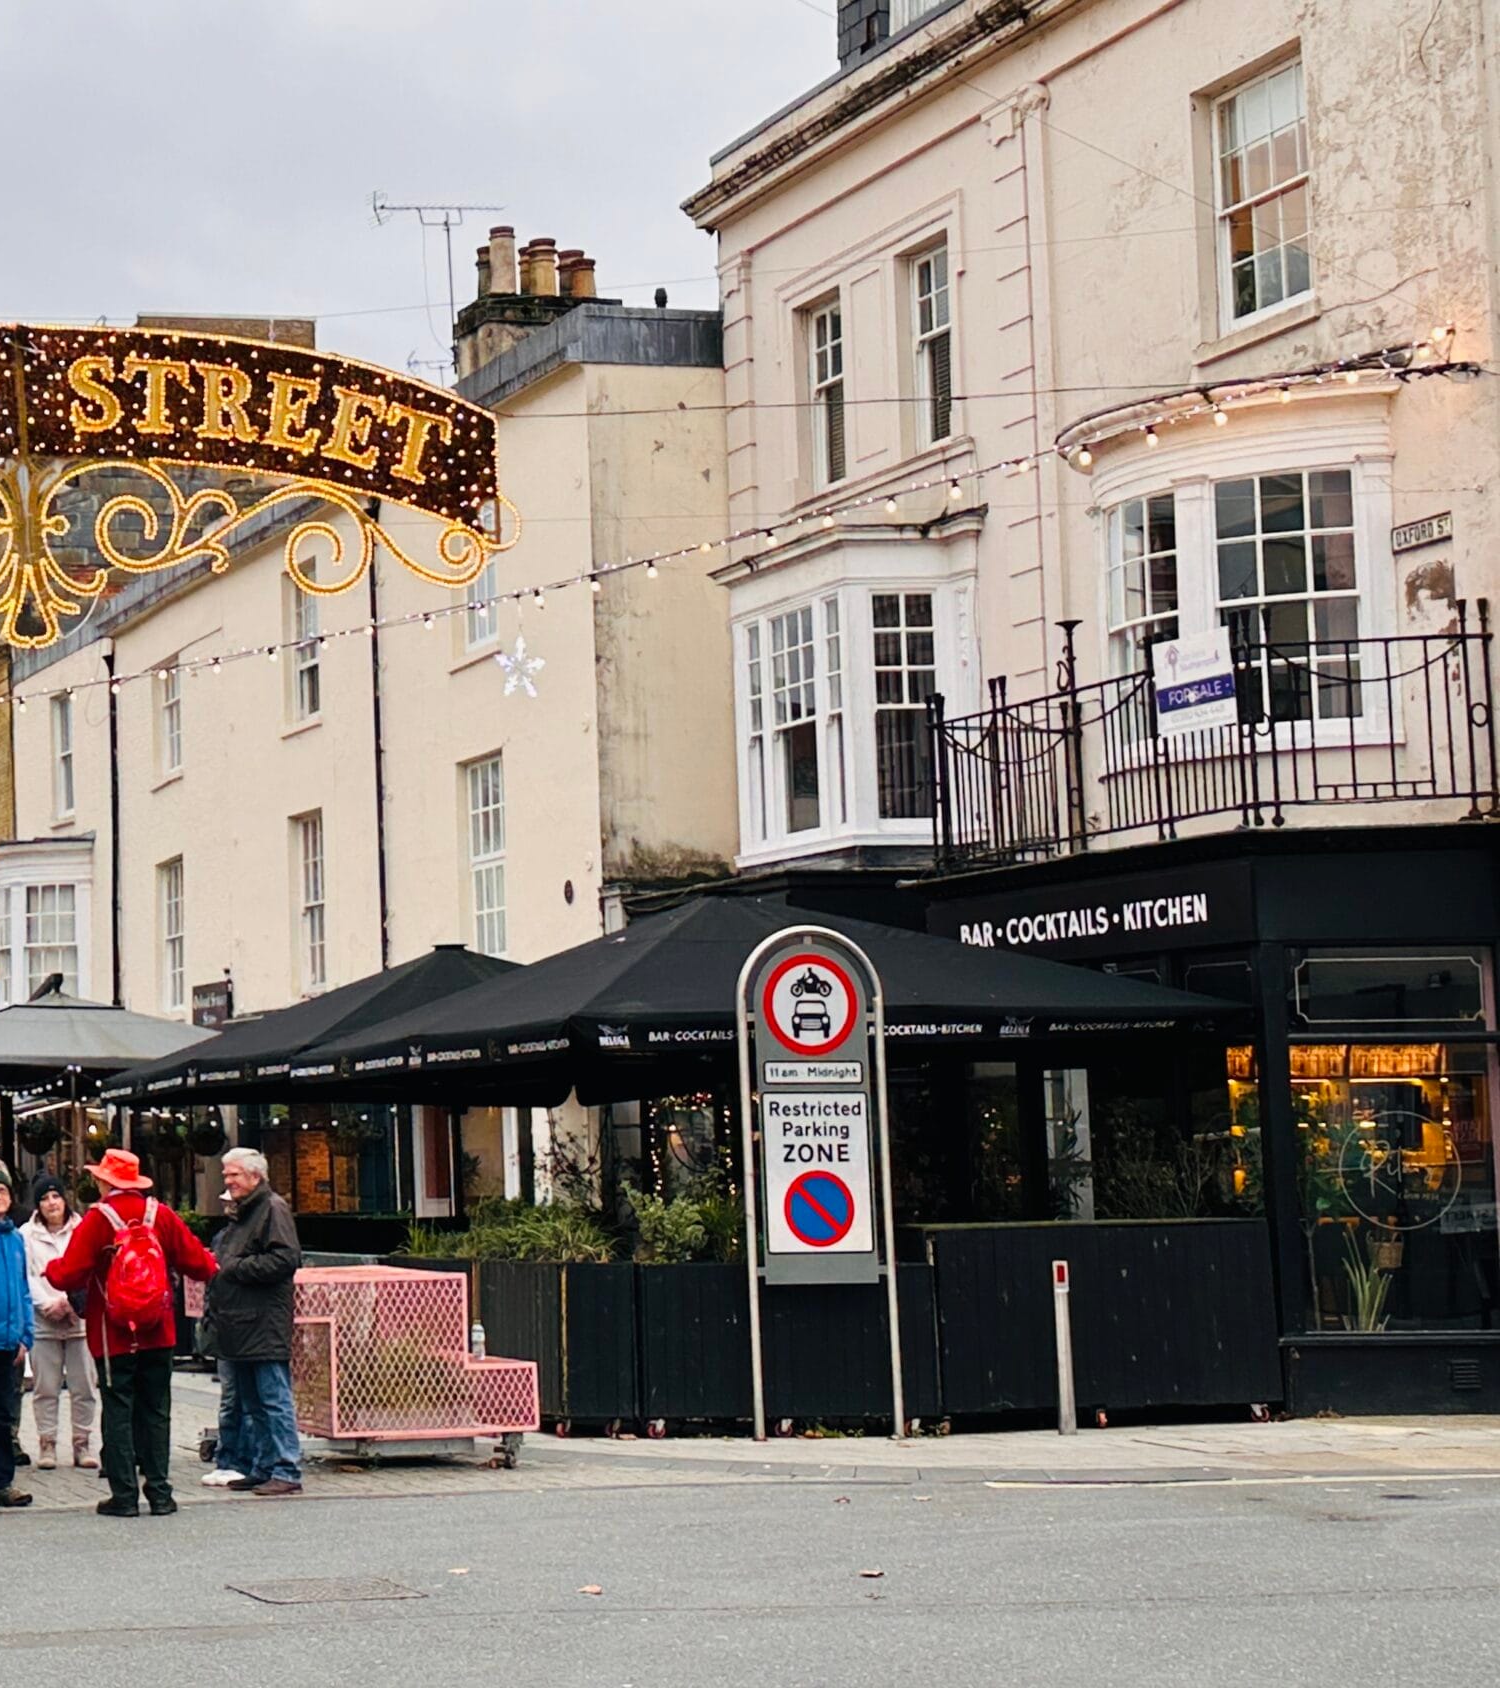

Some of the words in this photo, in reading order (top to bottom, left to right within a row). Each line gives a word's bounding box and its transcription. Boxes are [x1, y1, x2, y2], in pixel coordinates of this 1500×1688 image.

[67, 354, 453, 485] STREET
[1396, 521, 1433, 547] OXFORD
[960, 922, 995, 947] BAR
[1006, 906, 1109, 945] COCKTAILS
[1123, 893, 1208, 931] KITCHEN
[649, 1031, 670, 1042] BAR
[675, 1030, 734, 1041] COCKTAILS
[807, 1067, 857, 1078] Midnight
[769, 1101, 861, 1117] Restricted
[783, 1121, 850, 1139] Parking
[783, 1144, 850, 1163] ZONE
